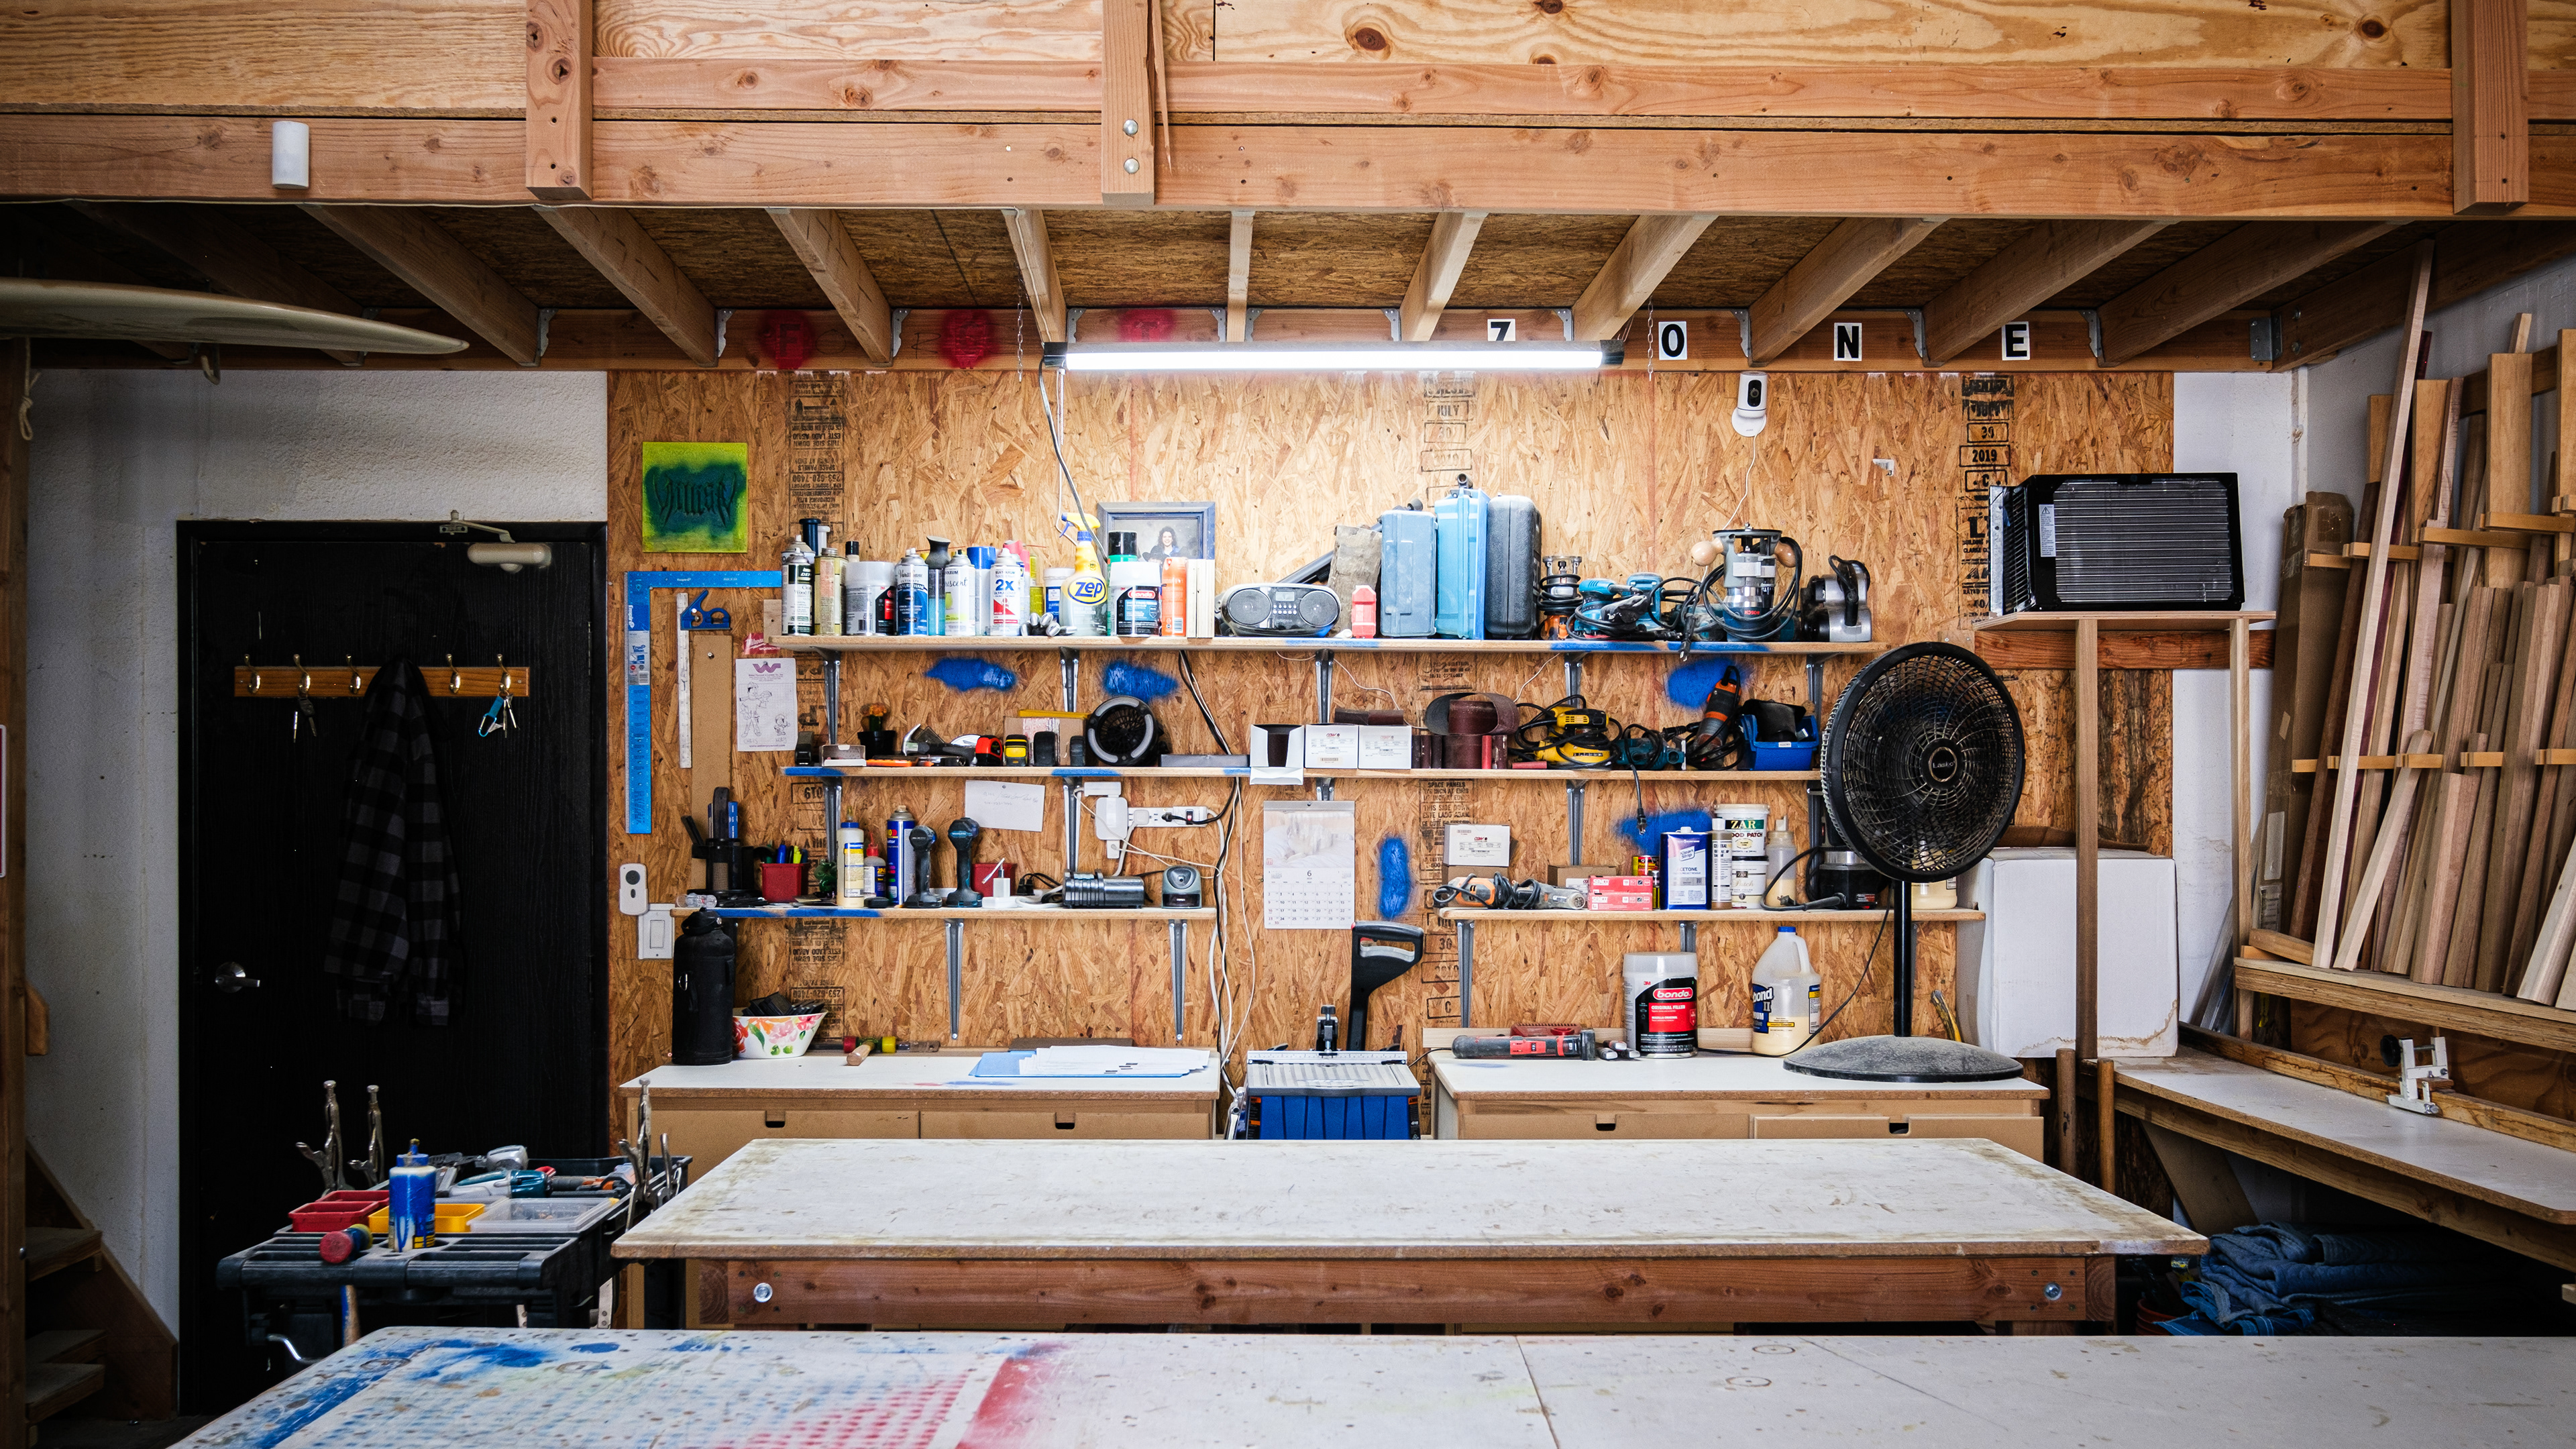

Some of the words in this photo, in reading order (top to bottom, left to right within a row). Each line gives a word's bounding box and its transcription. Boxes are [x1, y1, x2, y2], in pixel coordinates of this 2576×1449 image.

[1981, 426, 1995, 439] 30
[1972, 449, 1997, 462] 2019
[804, 787, 823, 799] 019
[1731, 819, 1756, 830] ZAR
[1439, 937, 1453, 950] 30
[1657, 989, 1689, 998] bondo
[1444, 1000, 1452, 1014] C
